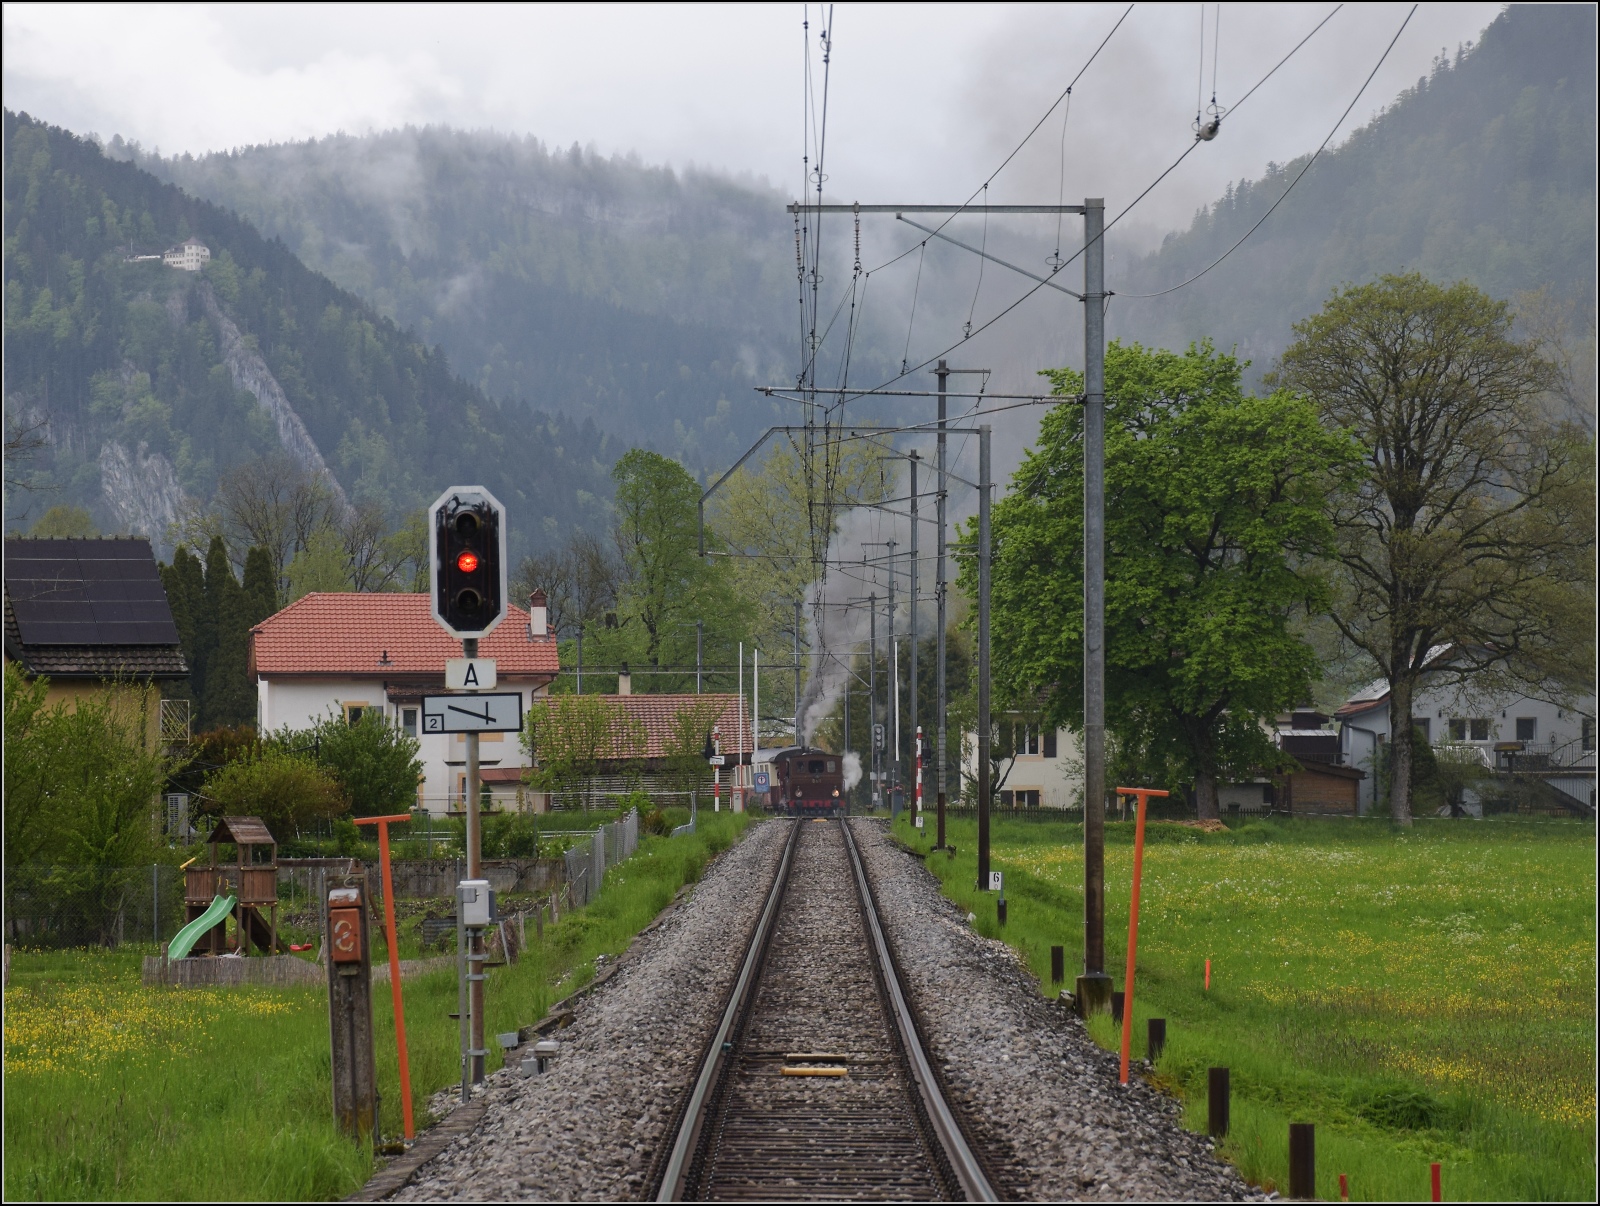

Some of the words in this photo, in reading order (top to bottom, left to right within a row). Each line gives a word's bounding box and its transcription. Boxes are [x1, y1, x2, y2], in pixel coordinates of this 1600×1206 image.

[463, 662, 479, 686] A
[429, 718, 438, 729] 2
[993, 872, 1000, 883] 6
